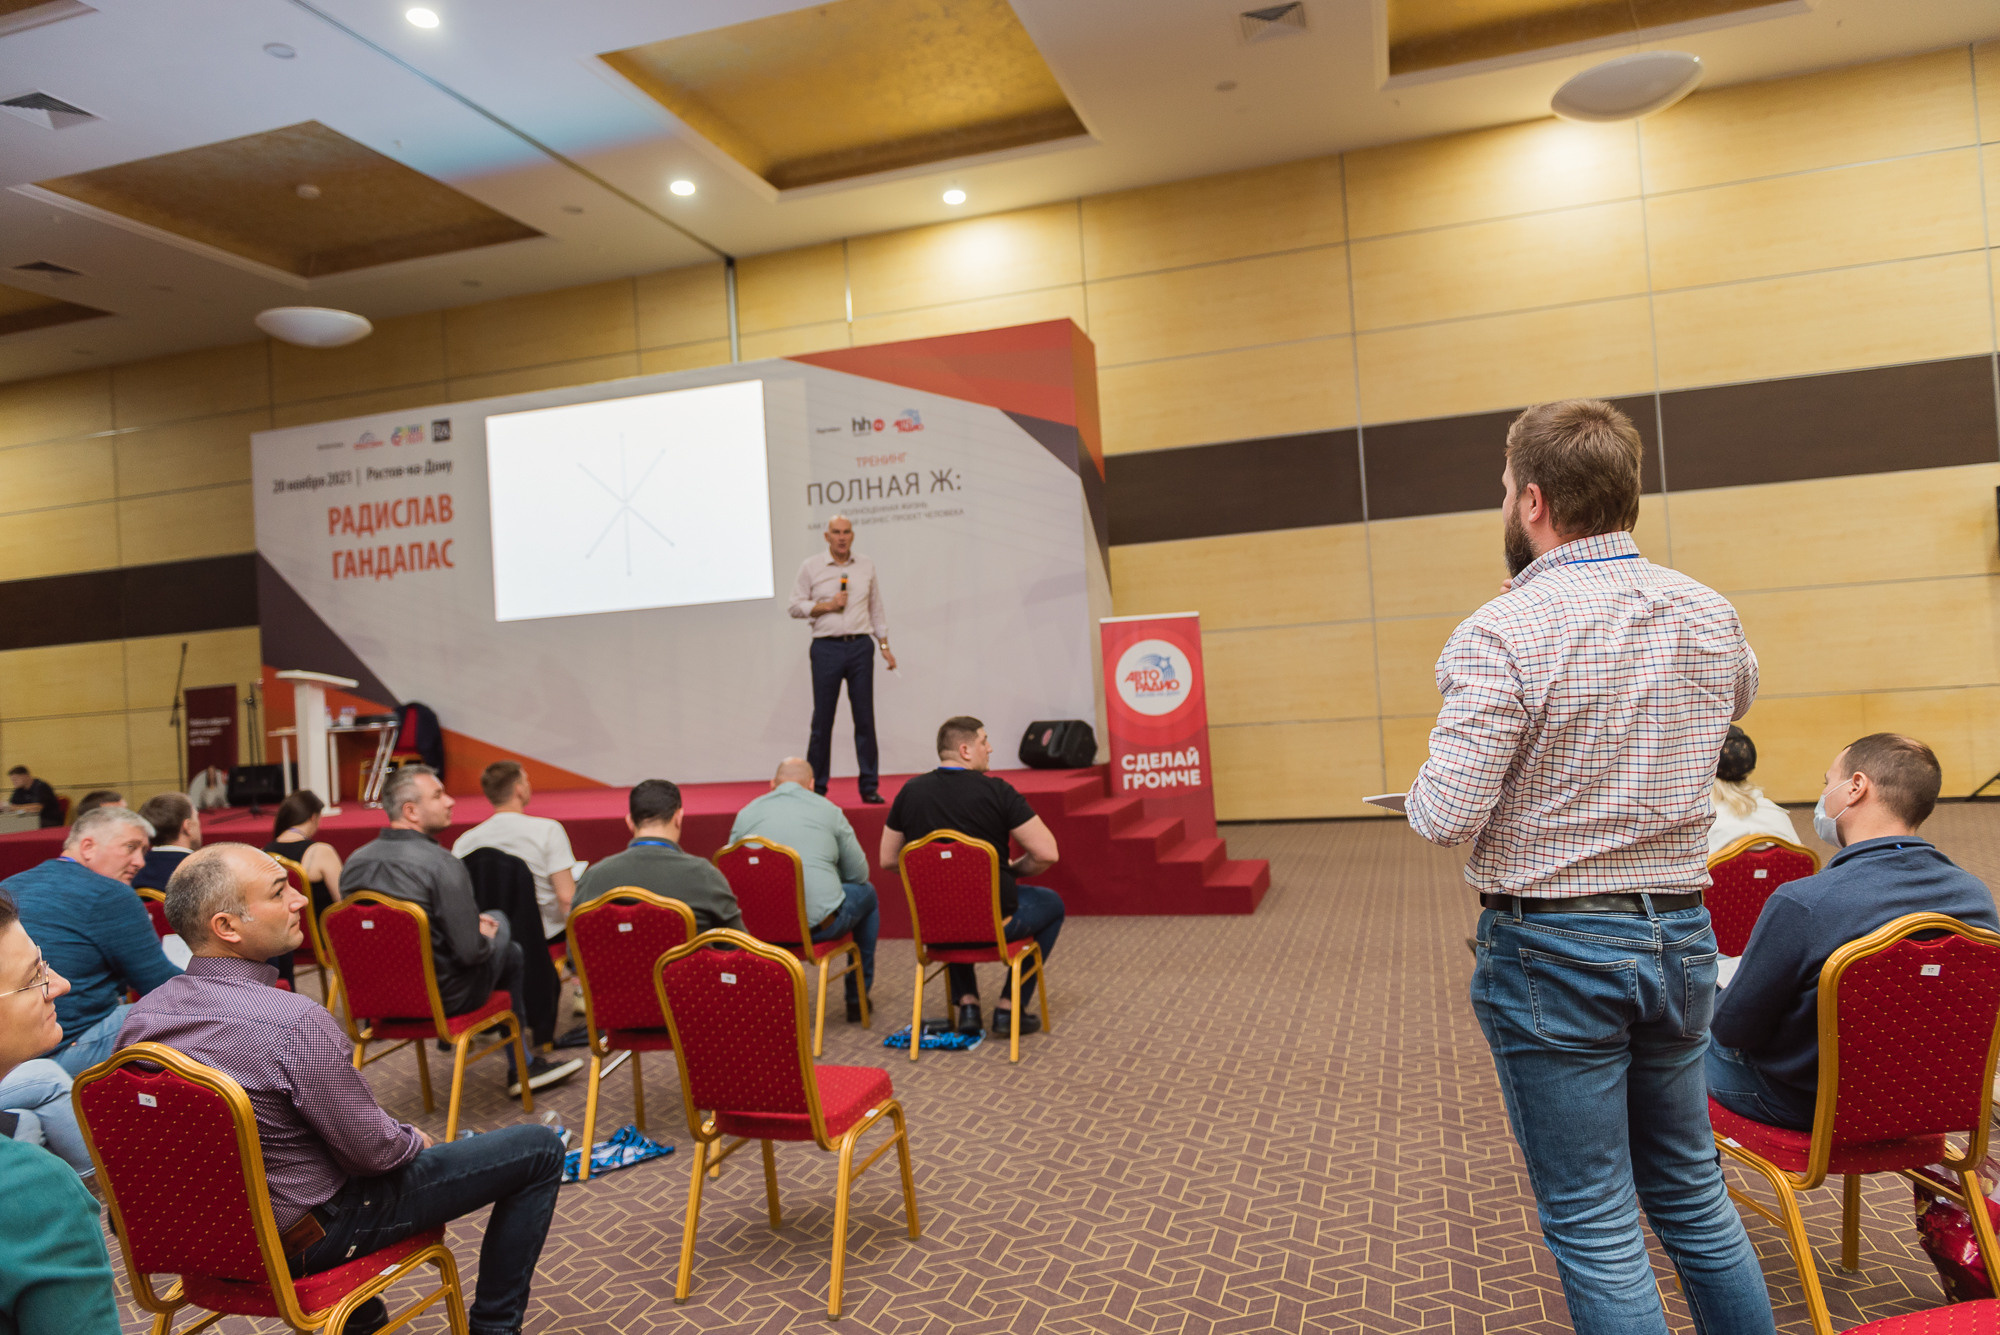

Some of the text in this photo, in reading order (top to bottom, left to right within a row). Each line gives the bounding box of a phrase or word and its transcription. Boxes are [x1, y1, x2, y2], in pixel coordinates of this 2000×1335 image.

[856, 452, 907, 468] ТРЕНИНГ
[807, 468, 962, 506] ПОЛНАЯ Ж:
[328, 494, 454, 538] РАДИСЛАВ
[332, 539, 454, 580] ГАНДАПАС
[1124, 669, 1160, 683] АВТО
[1135, 679, 1180, 693] РАДИО
[1121, 746, 1200, 771] СДЕЛАЙ
[1123, 769, 1201, 790] ГРОМЧЕ
